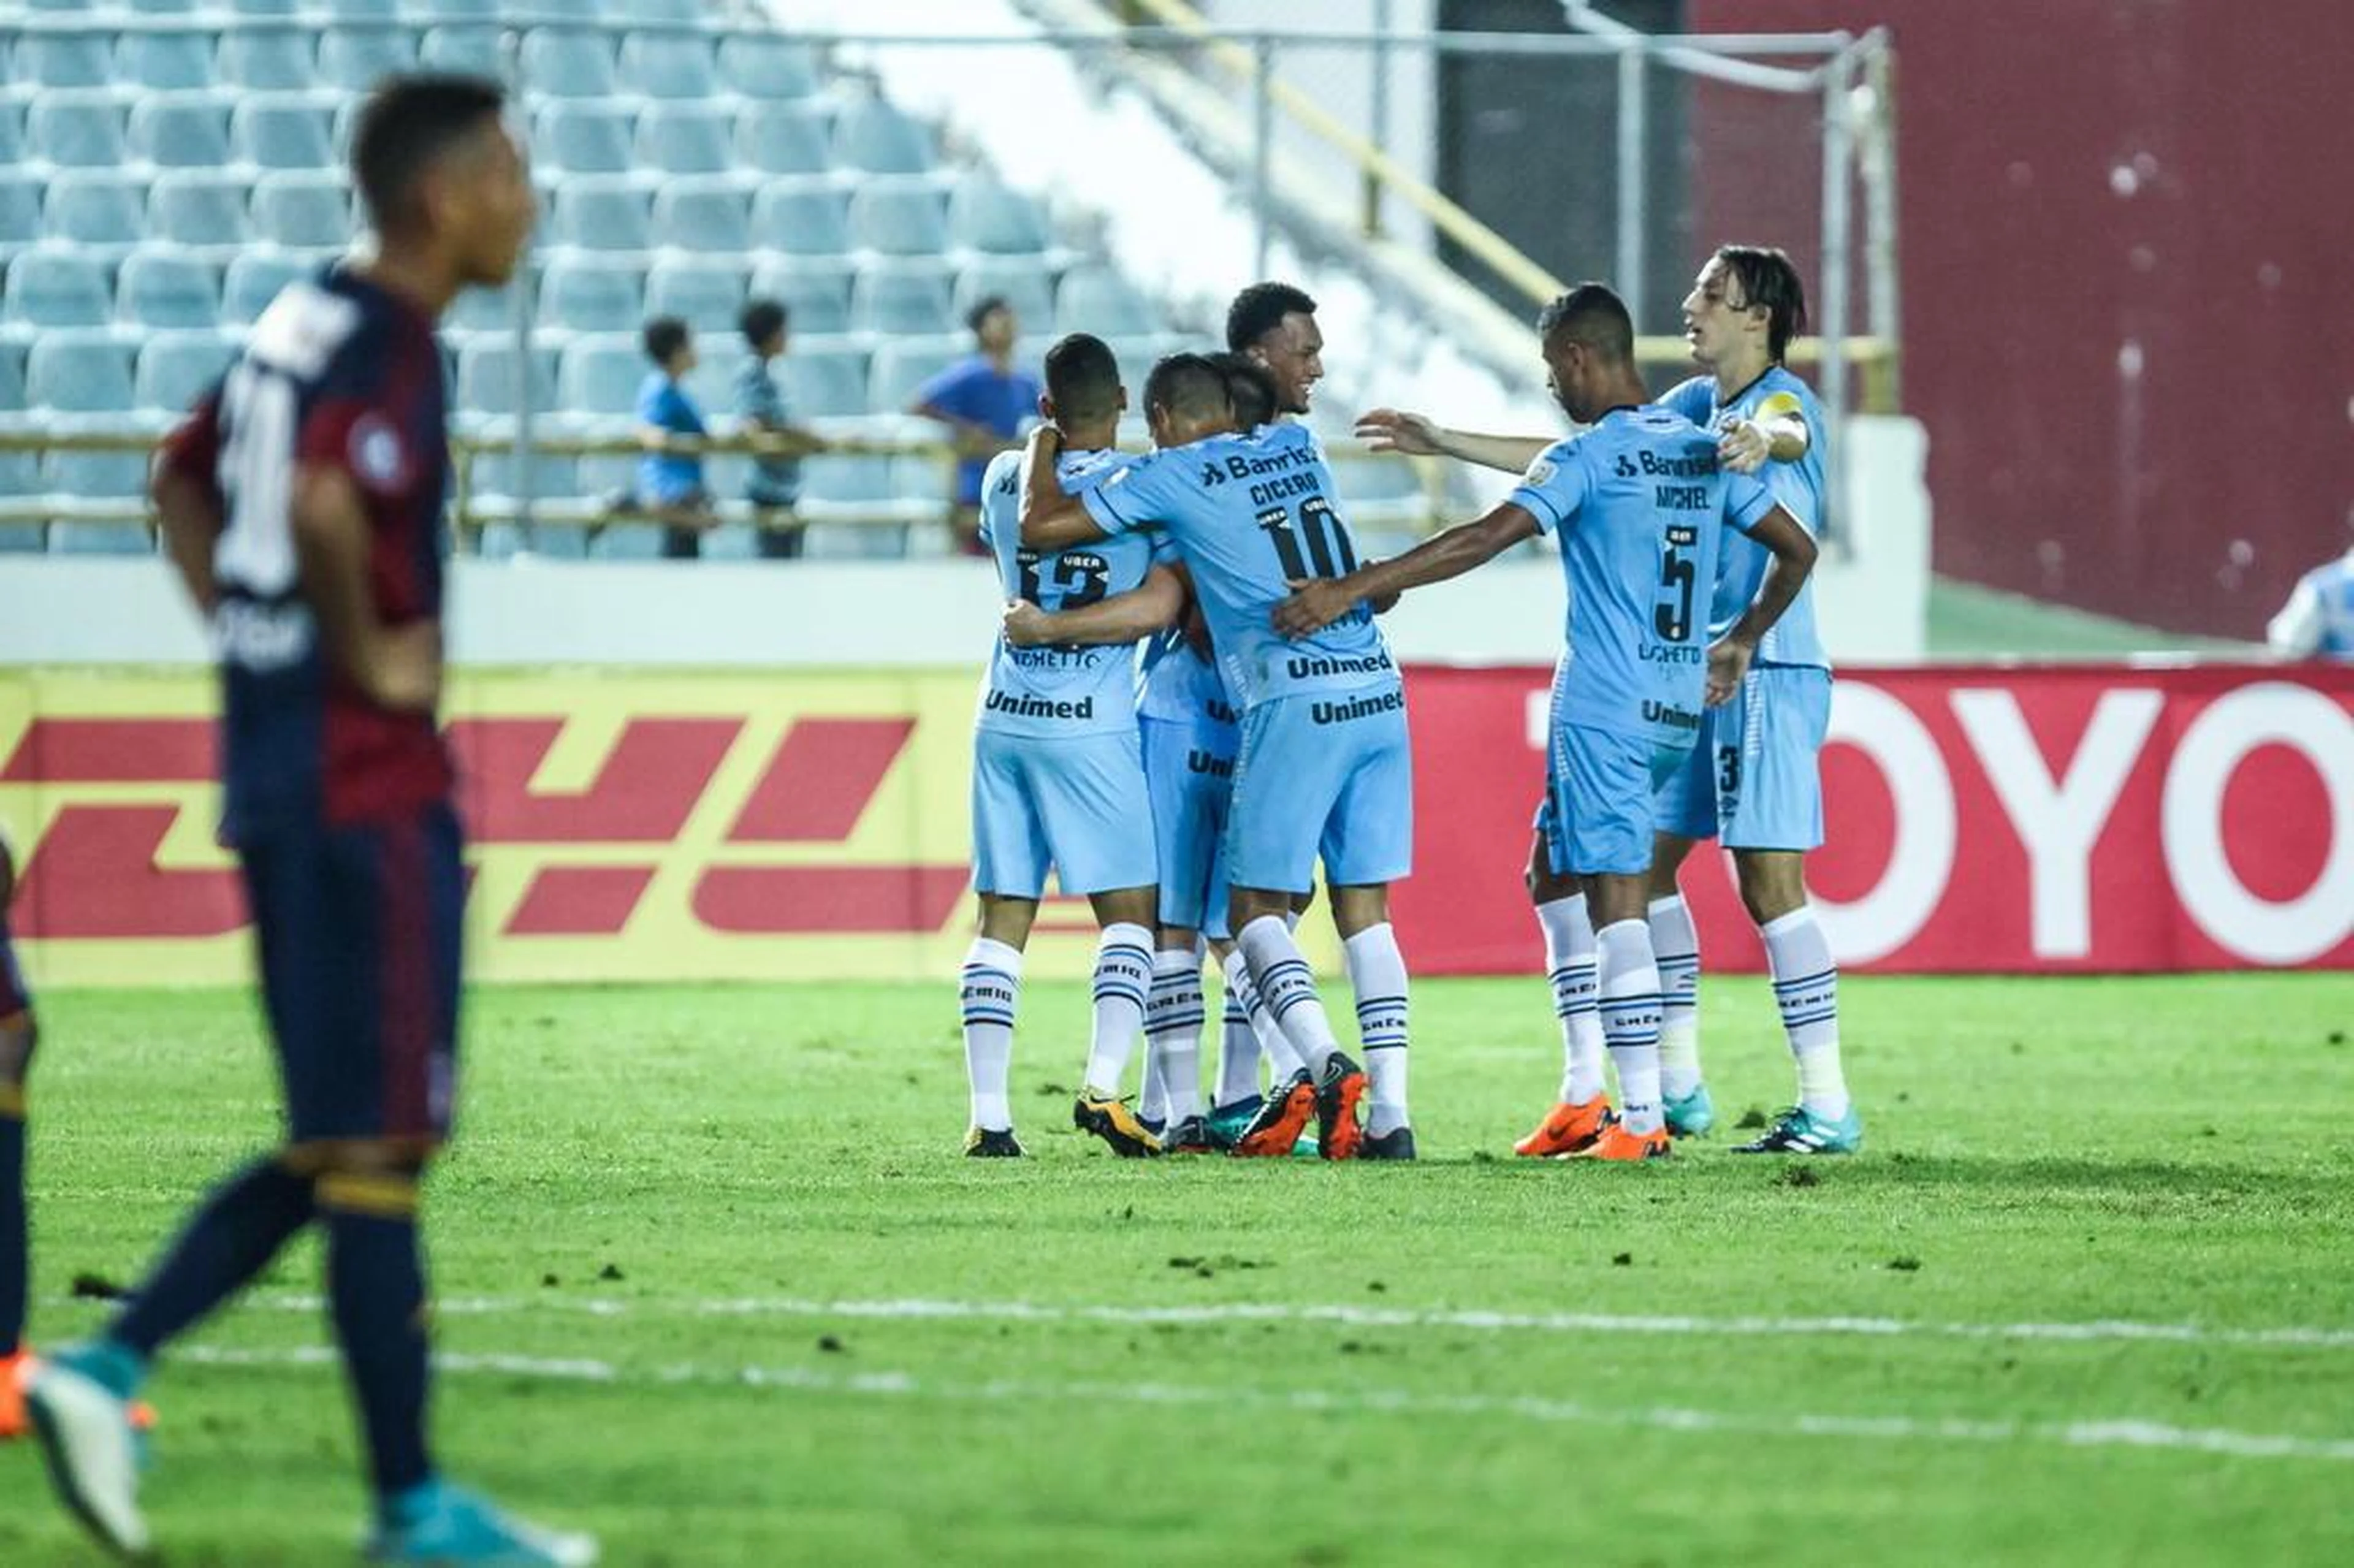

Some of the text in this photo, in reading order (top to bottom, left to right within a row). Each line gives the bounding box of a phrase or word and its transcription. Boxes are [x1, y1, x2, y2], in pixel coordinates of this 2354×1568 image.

[1064, 556, 1101, 568] UBER
[1655, 525, 1697, 642] 5
[1288, 649, 1392, 679] Unimed
[985, 688, 1093, 719] Unimed
[1720, 745, 1739, 793] 3
